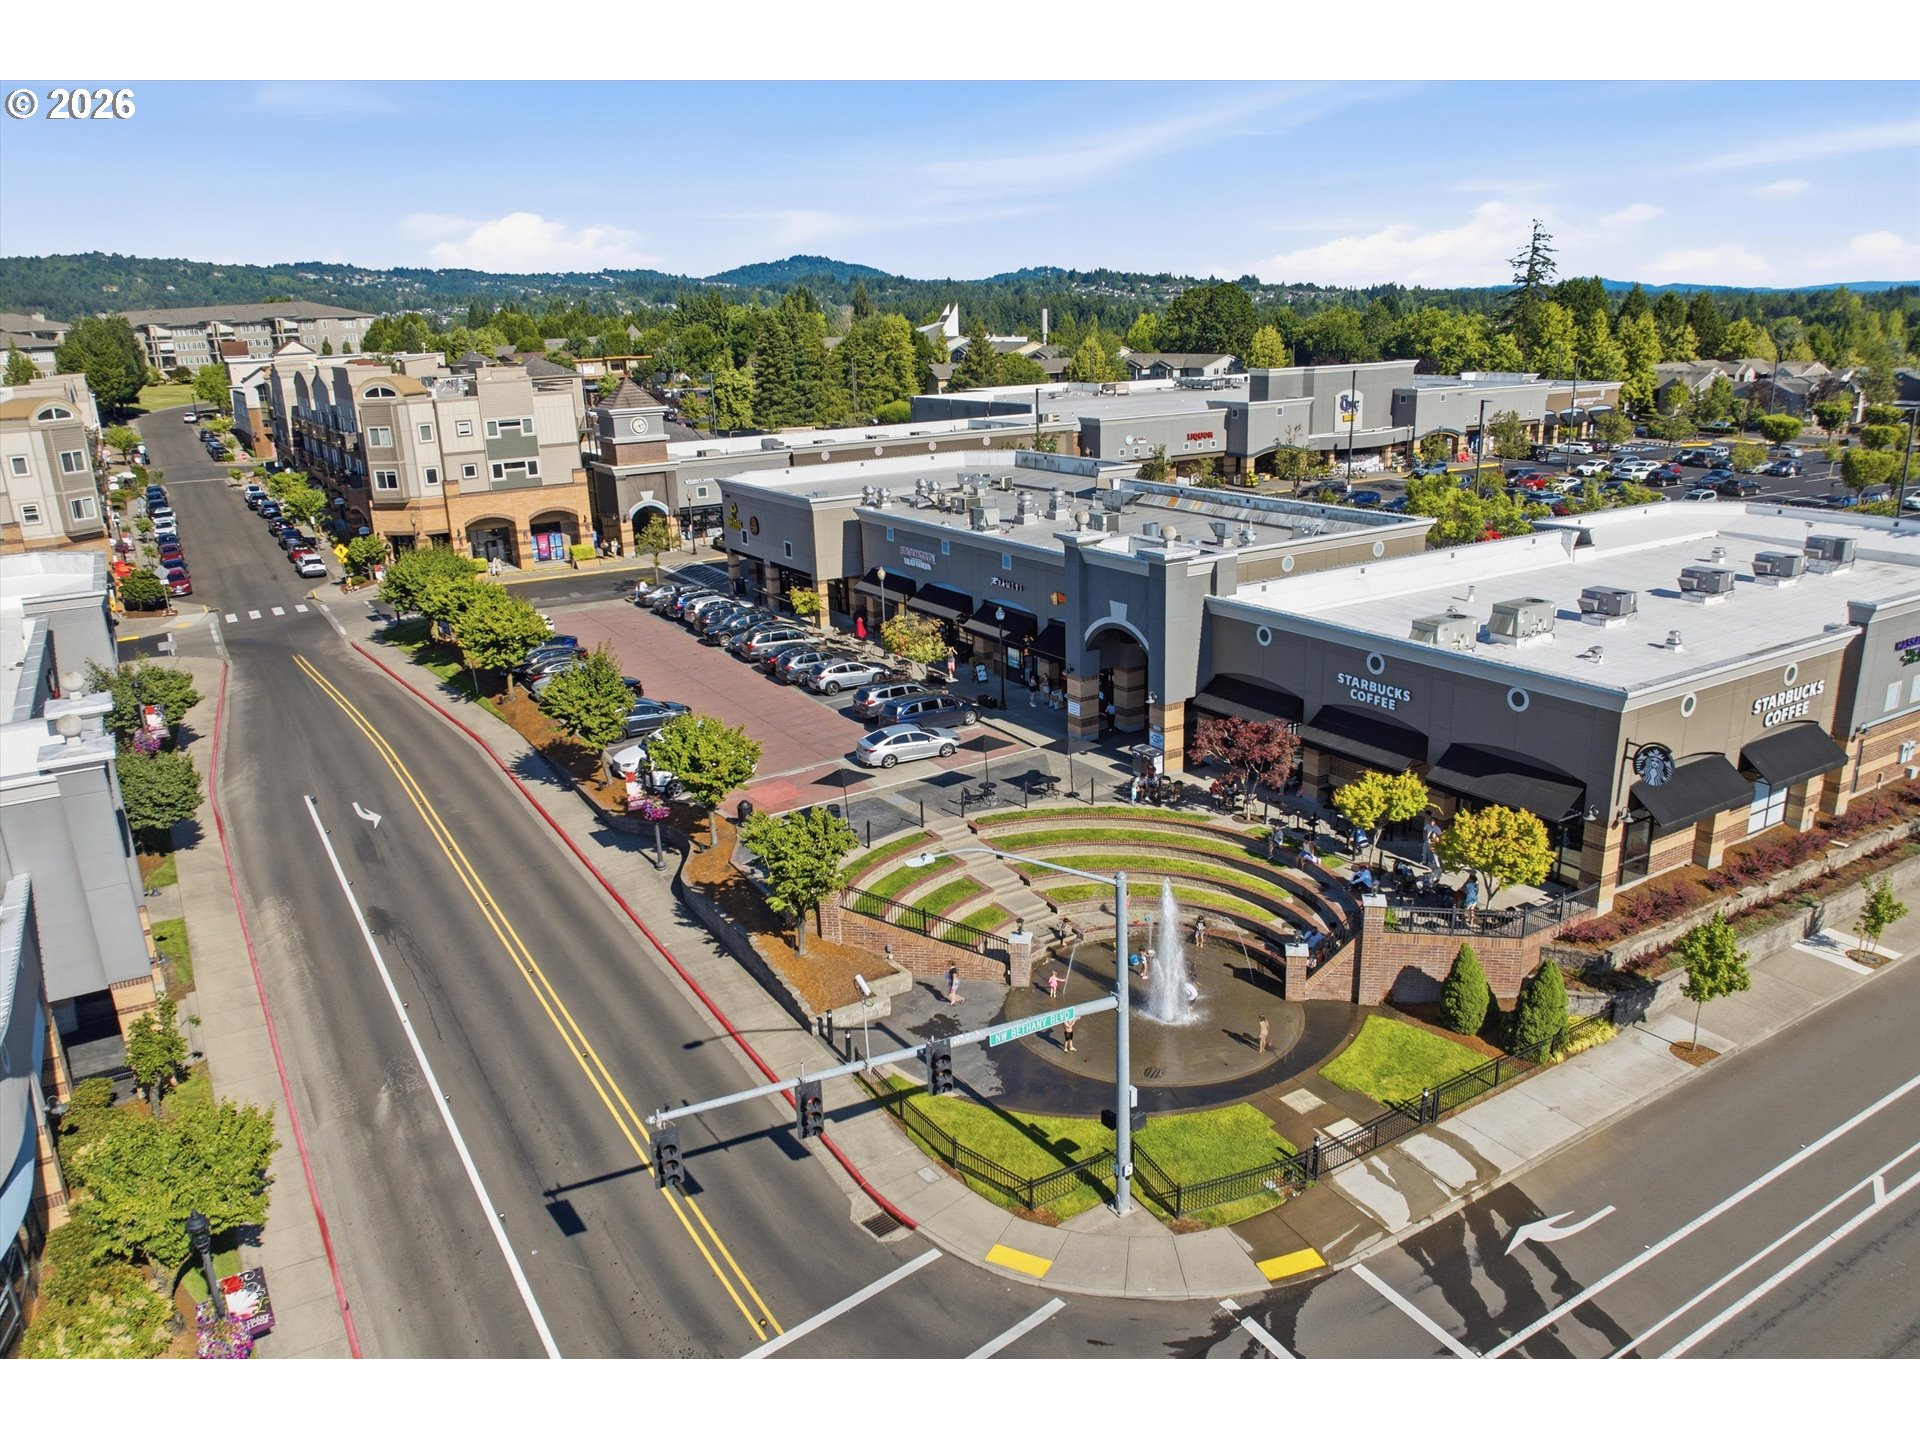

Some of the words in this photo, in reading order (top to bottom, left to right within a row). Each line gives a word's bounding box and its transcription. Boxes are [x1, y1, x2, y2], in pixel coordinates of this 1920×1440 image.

[1186, 431, 1214, 441] LIQUOR
[1337, 672, 1411, 702] STARBUCKS
[1350, 688, 1396, 711] COFFEE
[1752, 680, 1824, 715] STARBUCKS
[1763, 700, 1810, 727] COFFEE
[995, 1032, 1007, 1042] NW
[1011, 1019, 1047, 1037] BETHANY
[1050, 1010, 1070, 1024] BLVD
